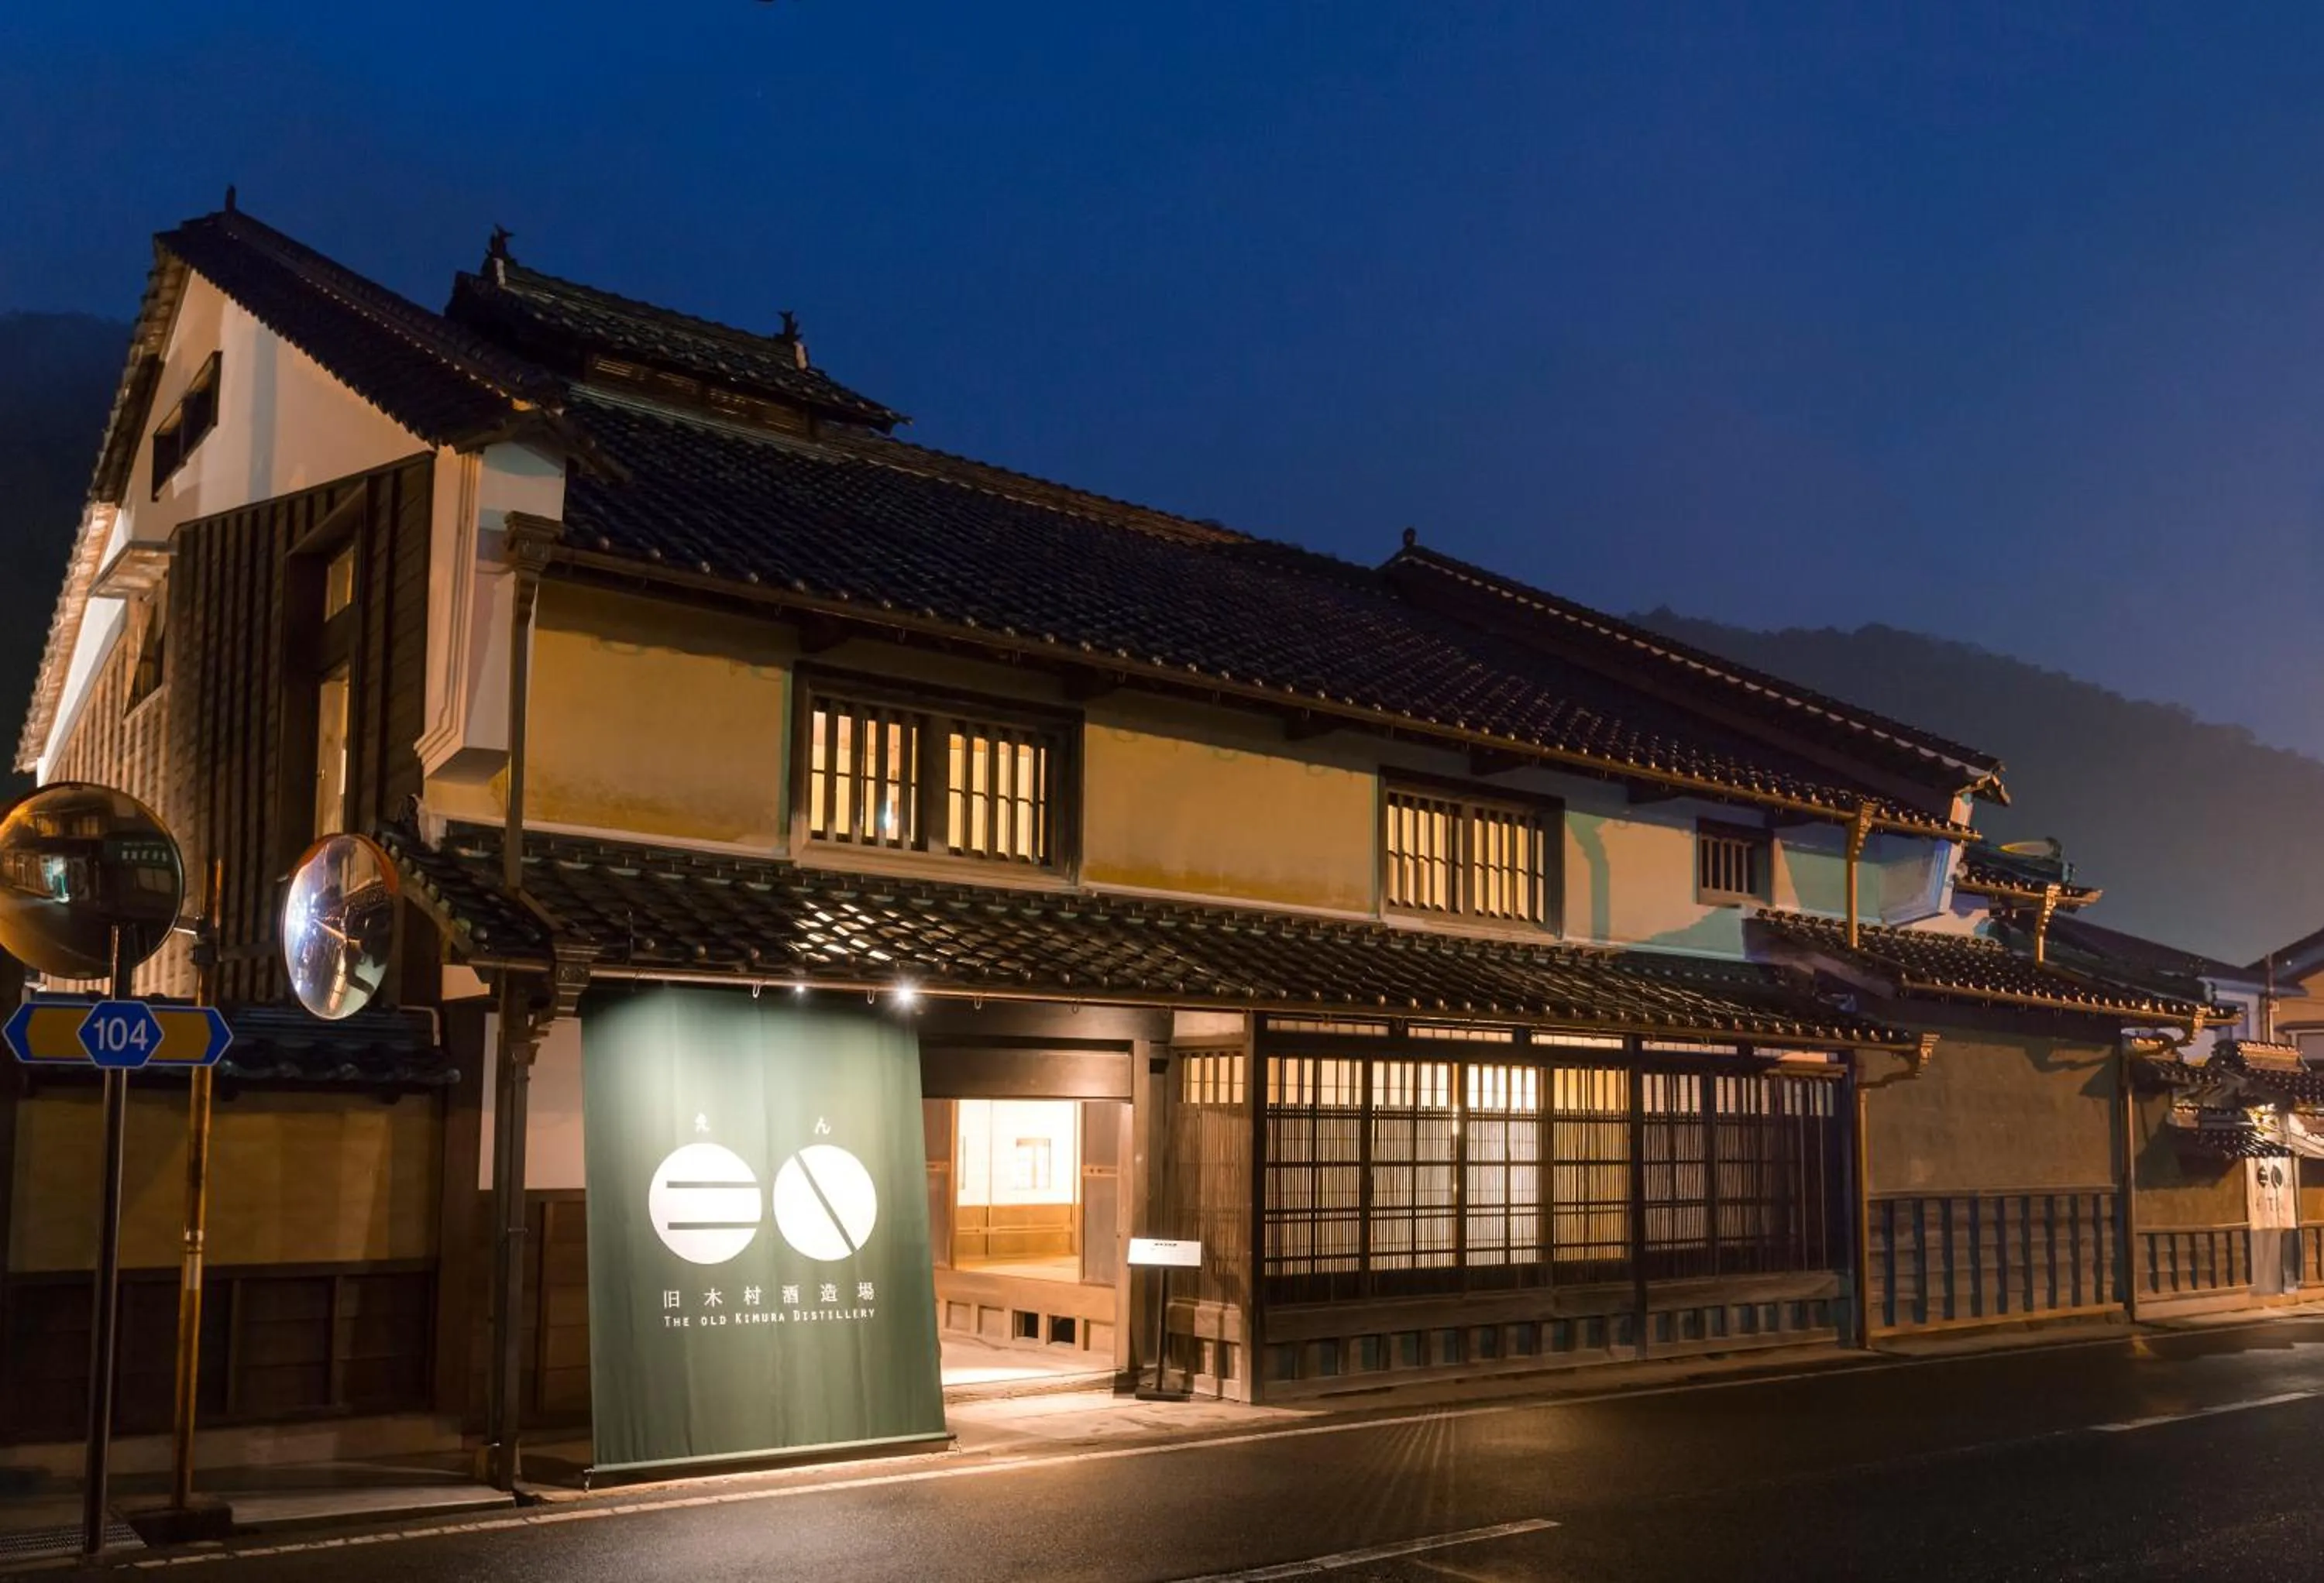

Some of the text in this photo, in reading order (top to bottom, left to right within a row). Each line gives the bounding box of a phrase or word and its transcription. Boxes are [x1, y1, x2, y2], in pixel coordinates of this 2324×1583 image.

[93, 1017, 149, 1052] 104
[663, 1282, 875, 1309] 旧木村酒造場
[664, 1307, 875, 1327] THE OLD KIMURA DISTILLERY
